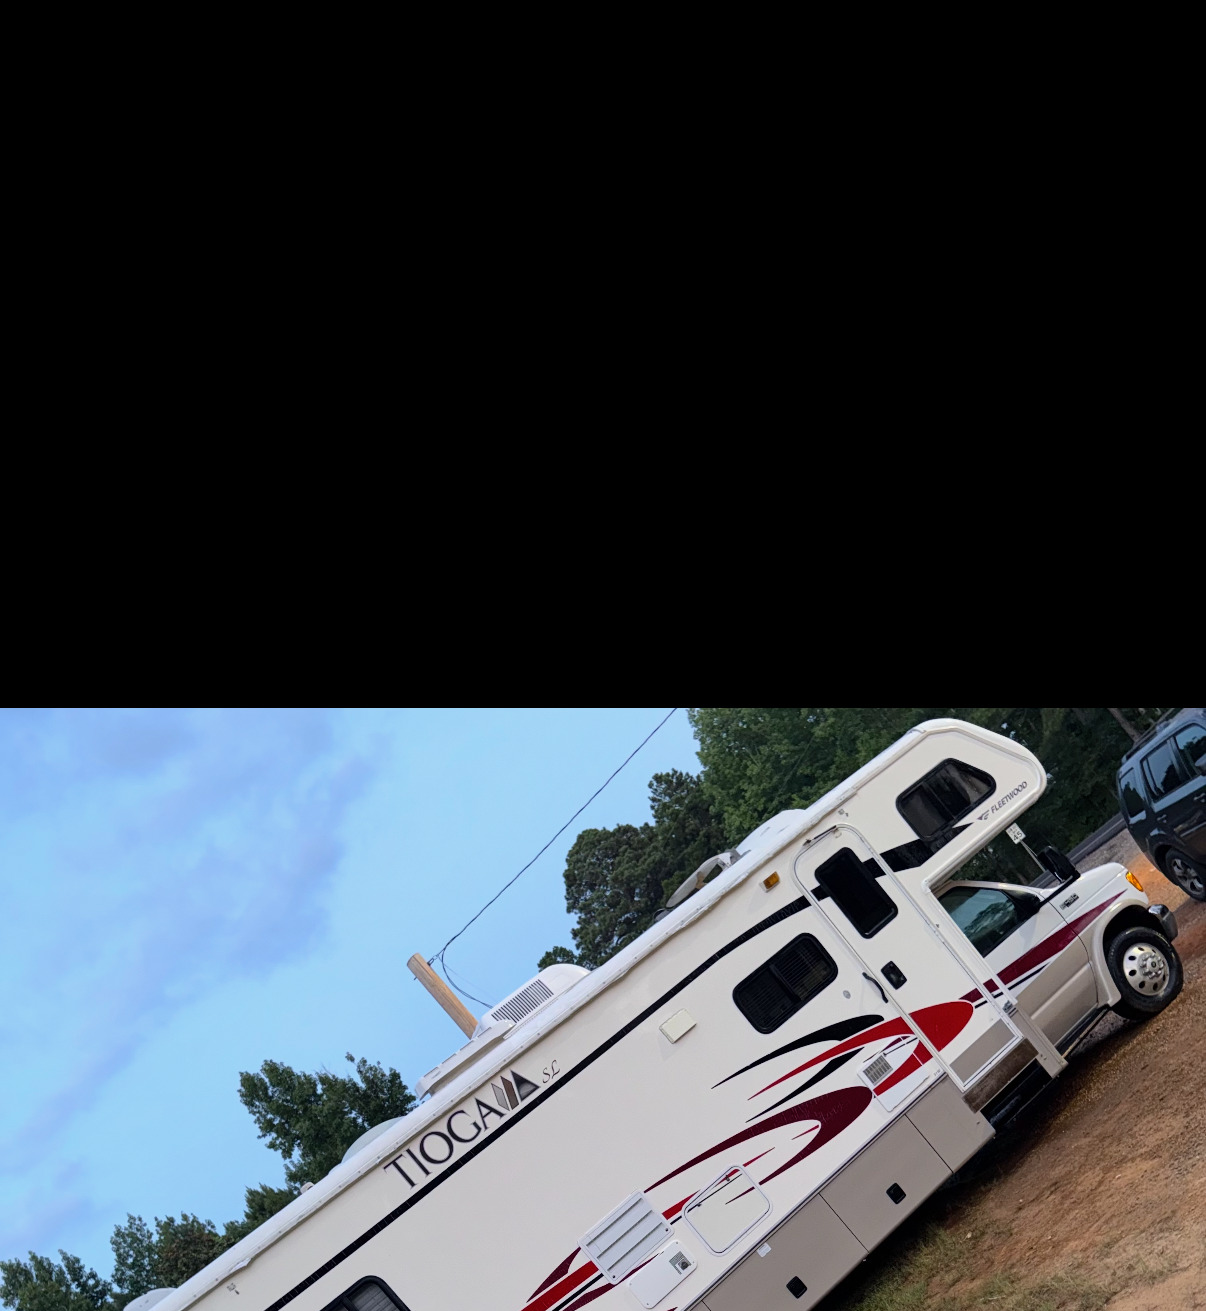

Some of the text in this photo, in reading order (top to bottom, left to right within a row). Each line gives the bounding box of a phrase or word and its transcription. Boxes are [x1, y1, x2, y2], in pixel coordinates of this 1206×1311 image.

[990, 781, 1028, 814] FLEETWOOD
[1013, 831, 1023, 841] 45
[383, 1059, 561, 1190] TIOGA SL
